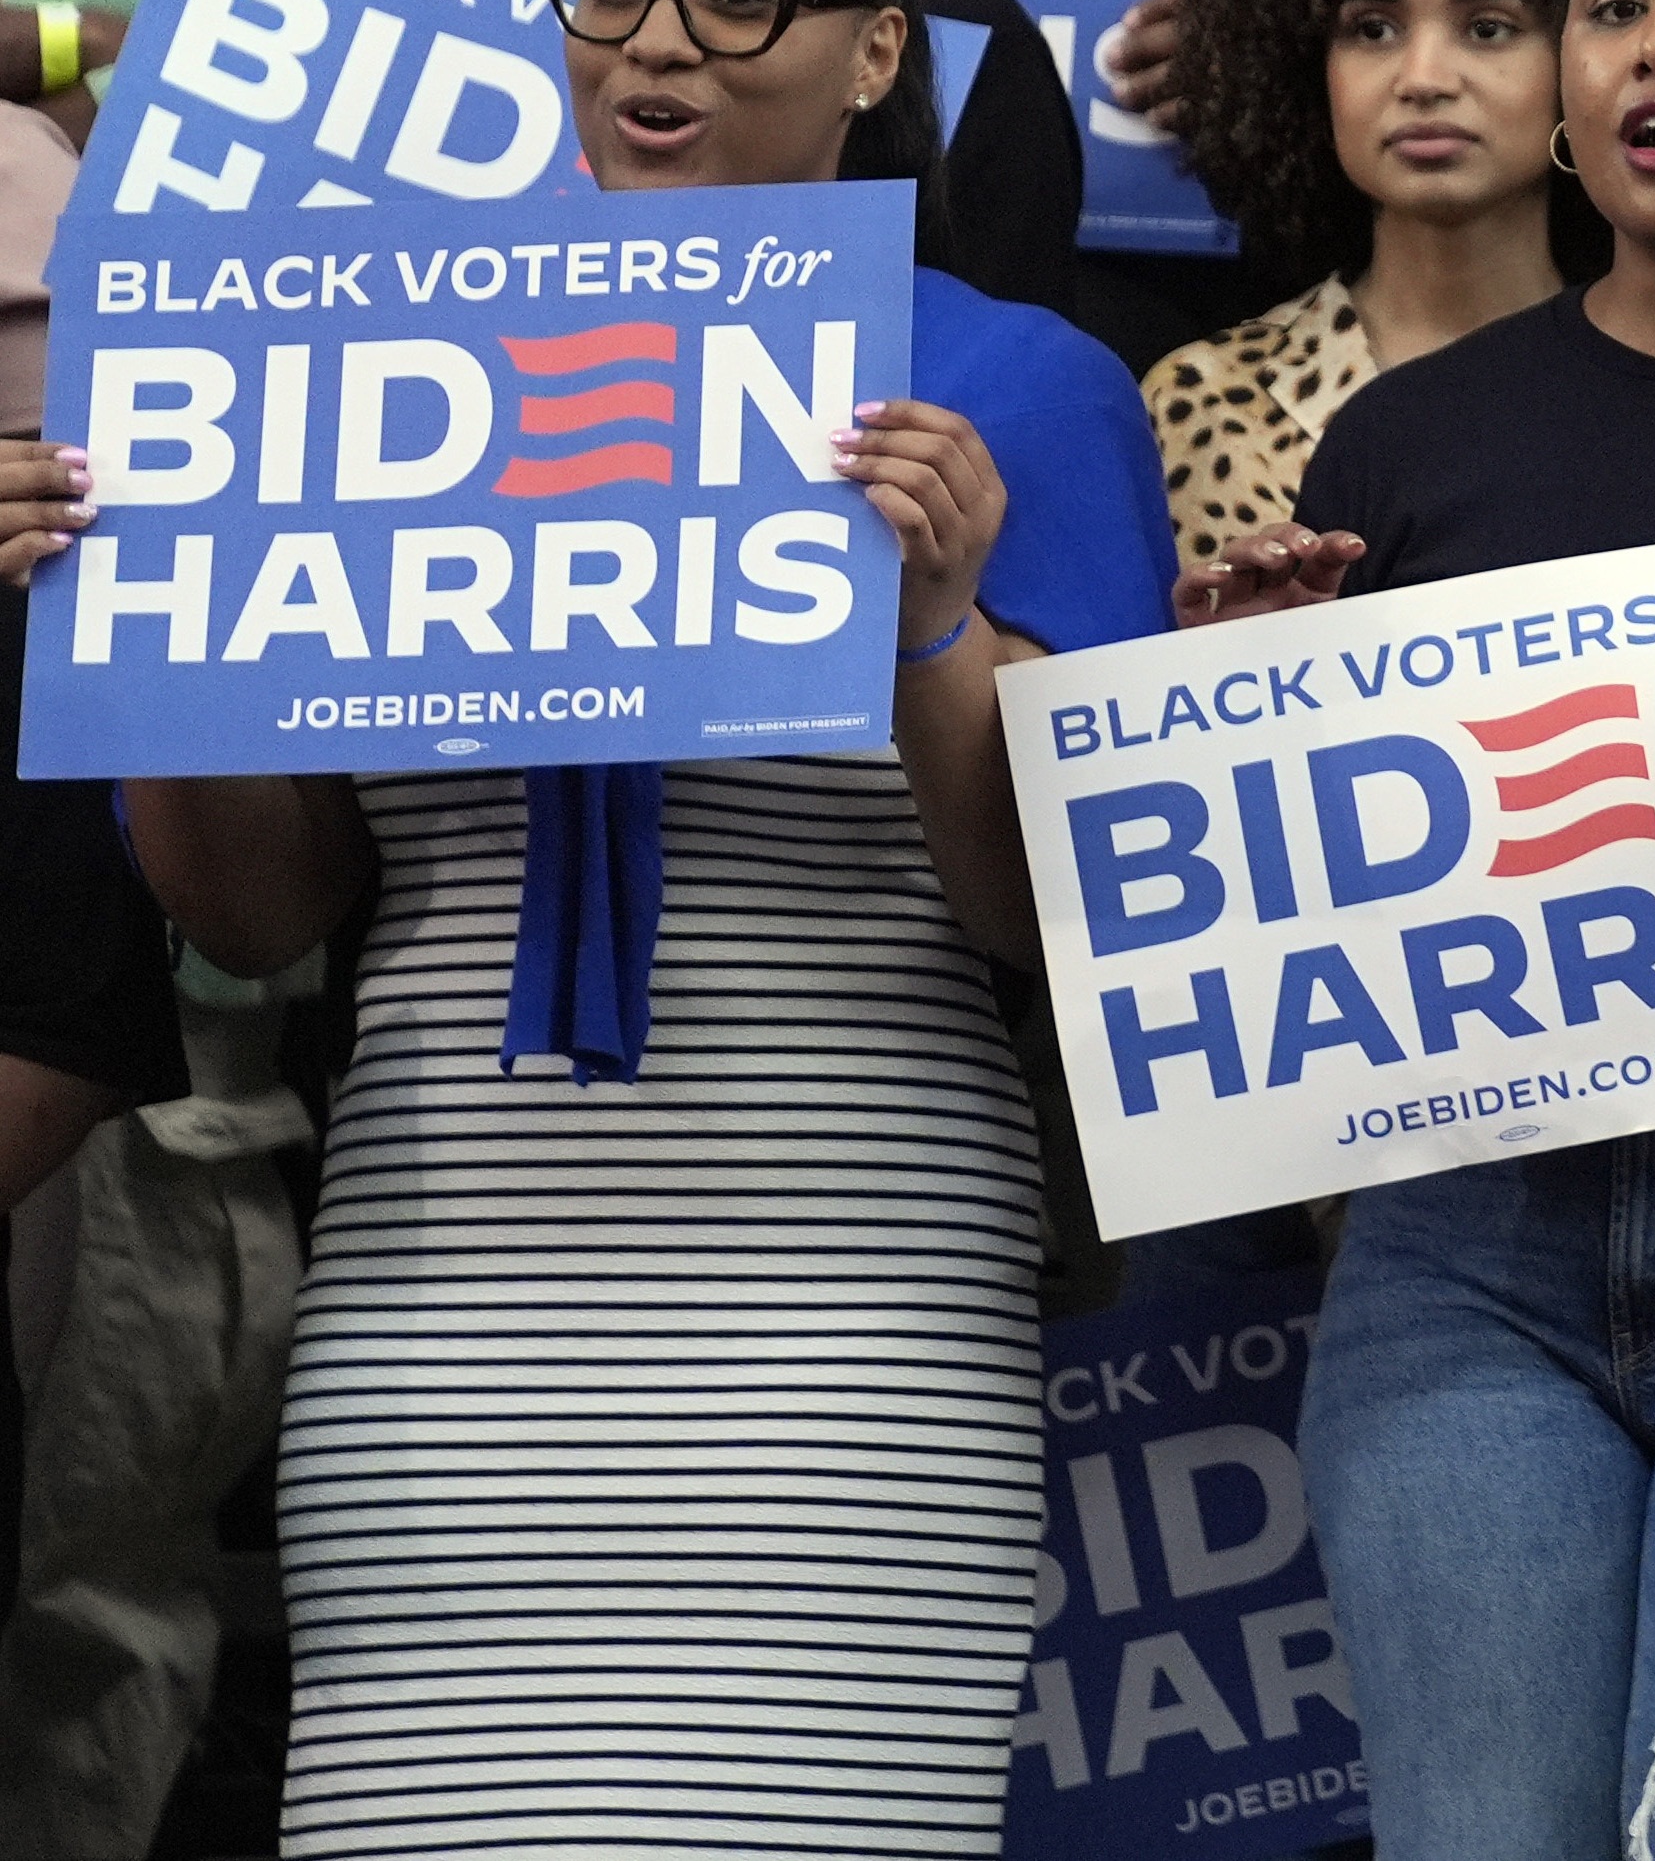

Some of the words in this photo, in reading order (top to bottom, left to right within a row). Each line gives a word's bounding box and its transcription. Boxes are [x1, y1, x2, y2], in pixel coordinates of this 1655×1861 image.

[96, 251, 373, 315] BLACK
[395, 237, 722, 303] VOTERS
[726, 235, 832, 306] for
[85, 320, 857, 507] BIDEN
[71, 510, 855, 665] HARRIS
[277, 687, 646, 730] JOEBIDEN.COM
[1048, 658, 1317, 761] BLACK
